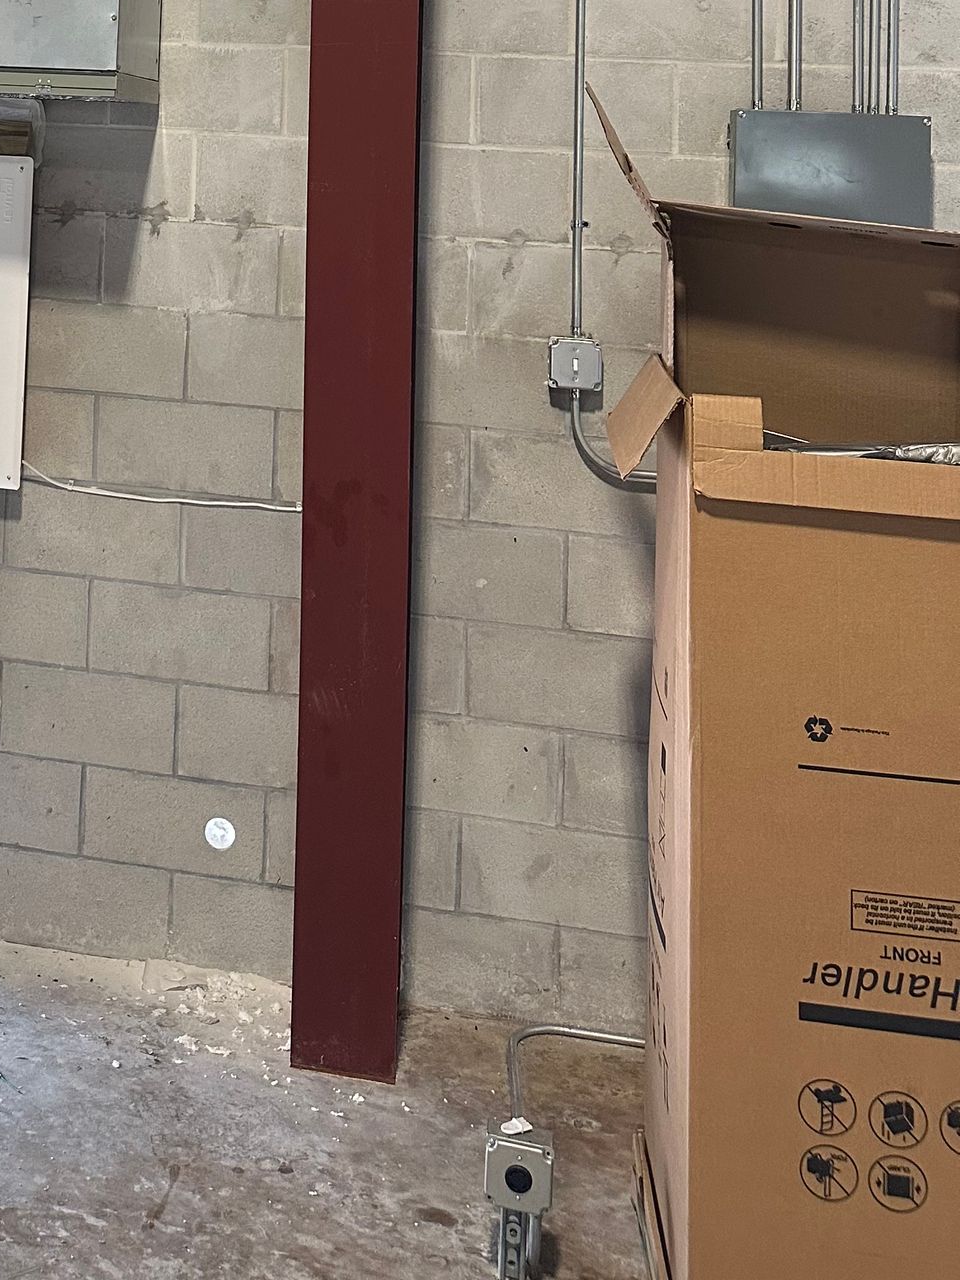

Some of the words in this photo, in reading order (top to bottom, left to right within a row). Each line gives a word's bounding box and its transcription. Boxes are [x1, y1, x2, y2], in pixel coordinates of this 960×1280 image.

[864, 895, 889, 905] carton)
[912, 908, 930, 916] must
[937, 909, 960, 920] osition,
[907, 923, 918, 931] the
[913, 917, 953, 927] transported
[880, 945, 942, 966] FRONT
[802, 962, 960, 1011] Handler
